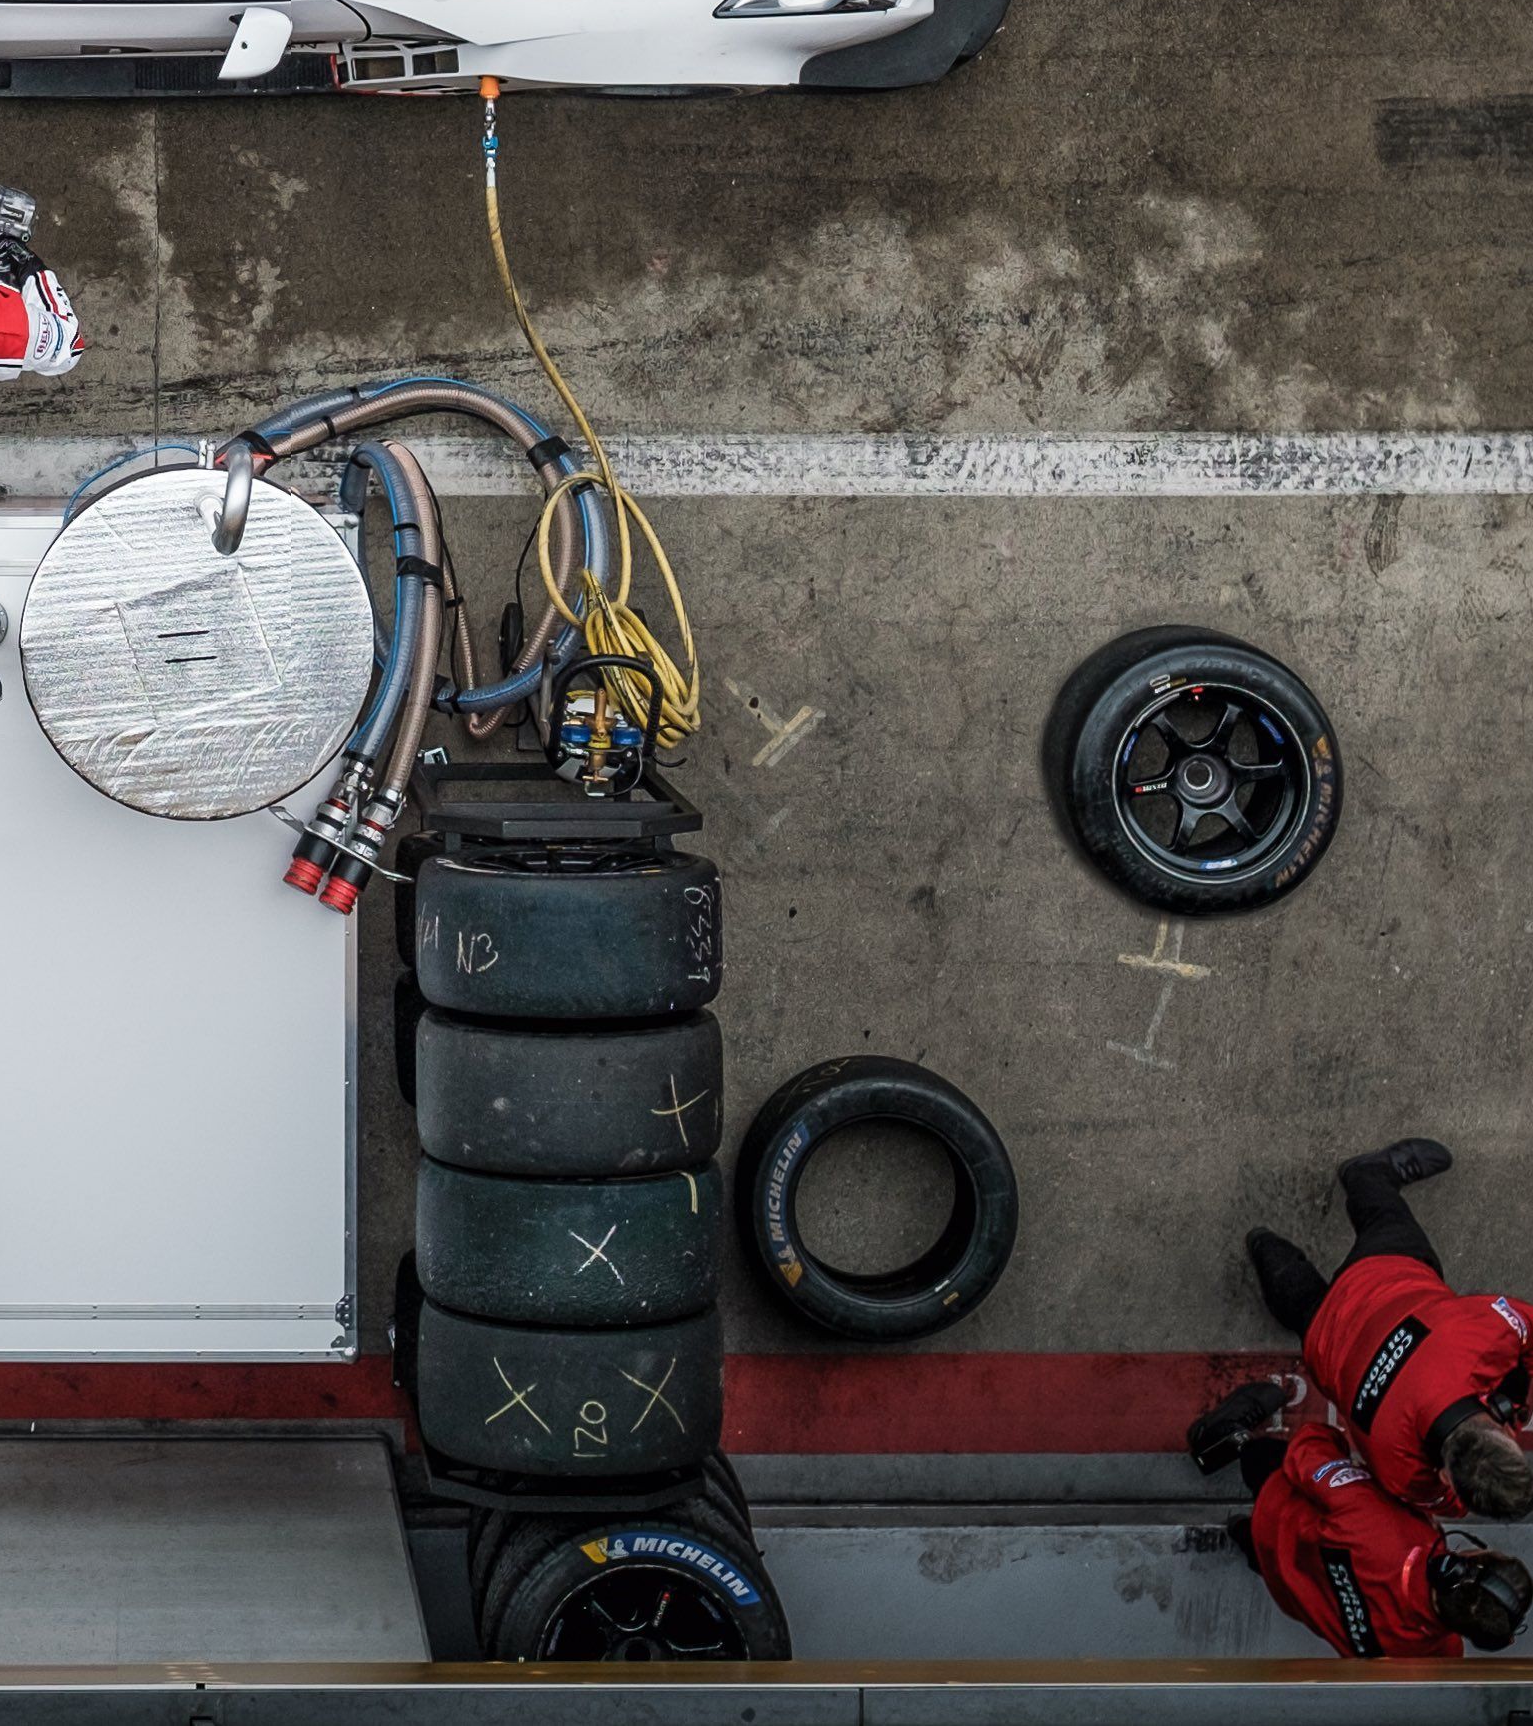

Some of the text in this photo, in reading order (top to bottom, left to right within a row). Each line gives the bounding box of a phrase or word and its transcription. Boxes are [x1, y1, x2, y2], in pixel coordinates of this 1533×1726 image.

[770, 1132, 803, 1243] MICHELIN
[1370, 1335, 1414, 1398] CORSA
[633, 1536, 751, 1598] MICHELIN
